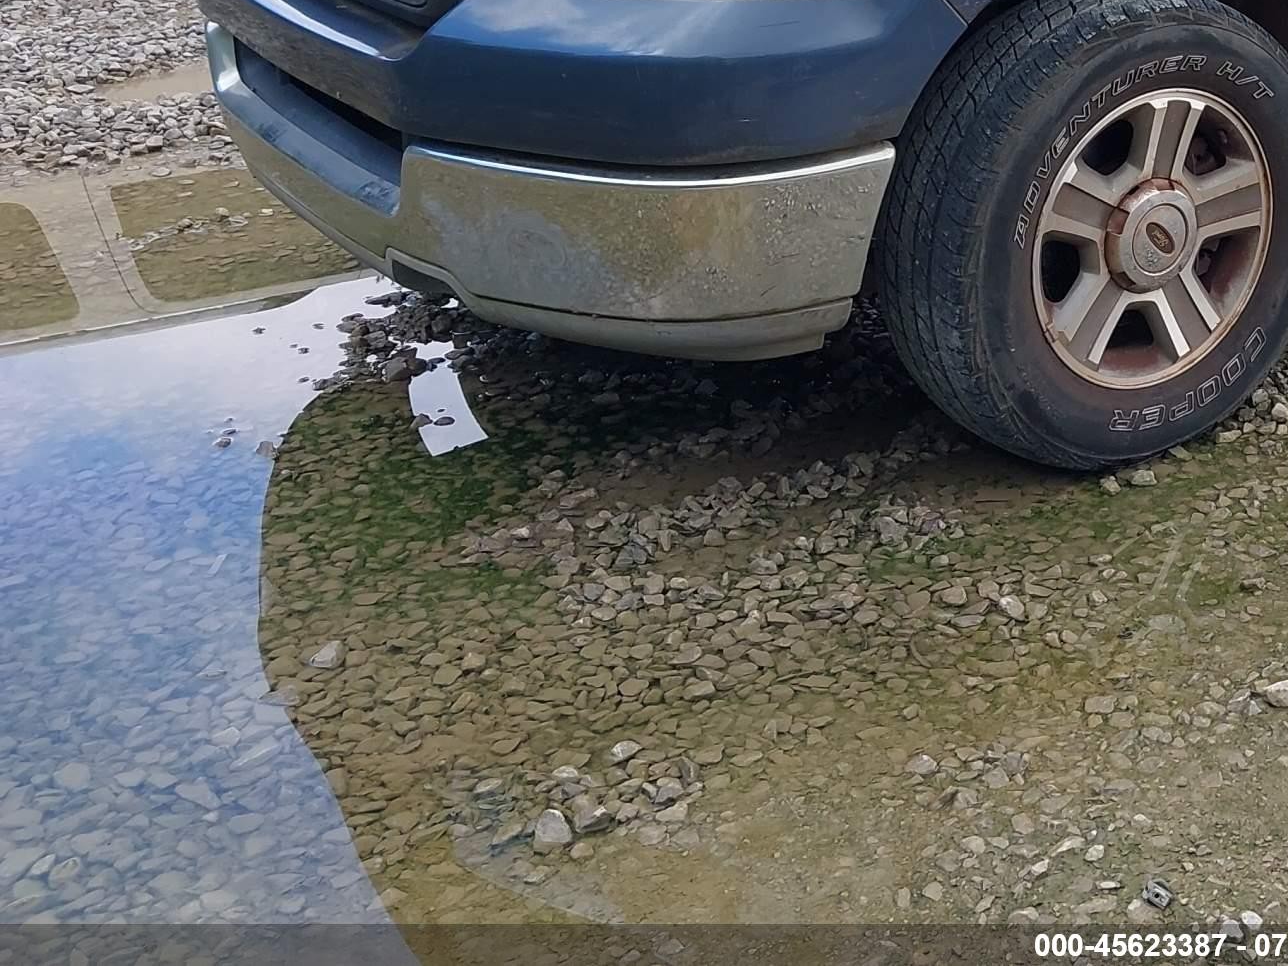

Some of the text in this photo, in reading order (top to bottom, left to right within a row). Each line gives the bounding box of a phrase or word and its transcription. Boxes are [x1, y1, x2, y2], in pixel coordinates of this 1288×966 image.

[1012, 54, 1275, 250] ADVENTURER H/T
[1108, 325, 1268, 432] COOPER
